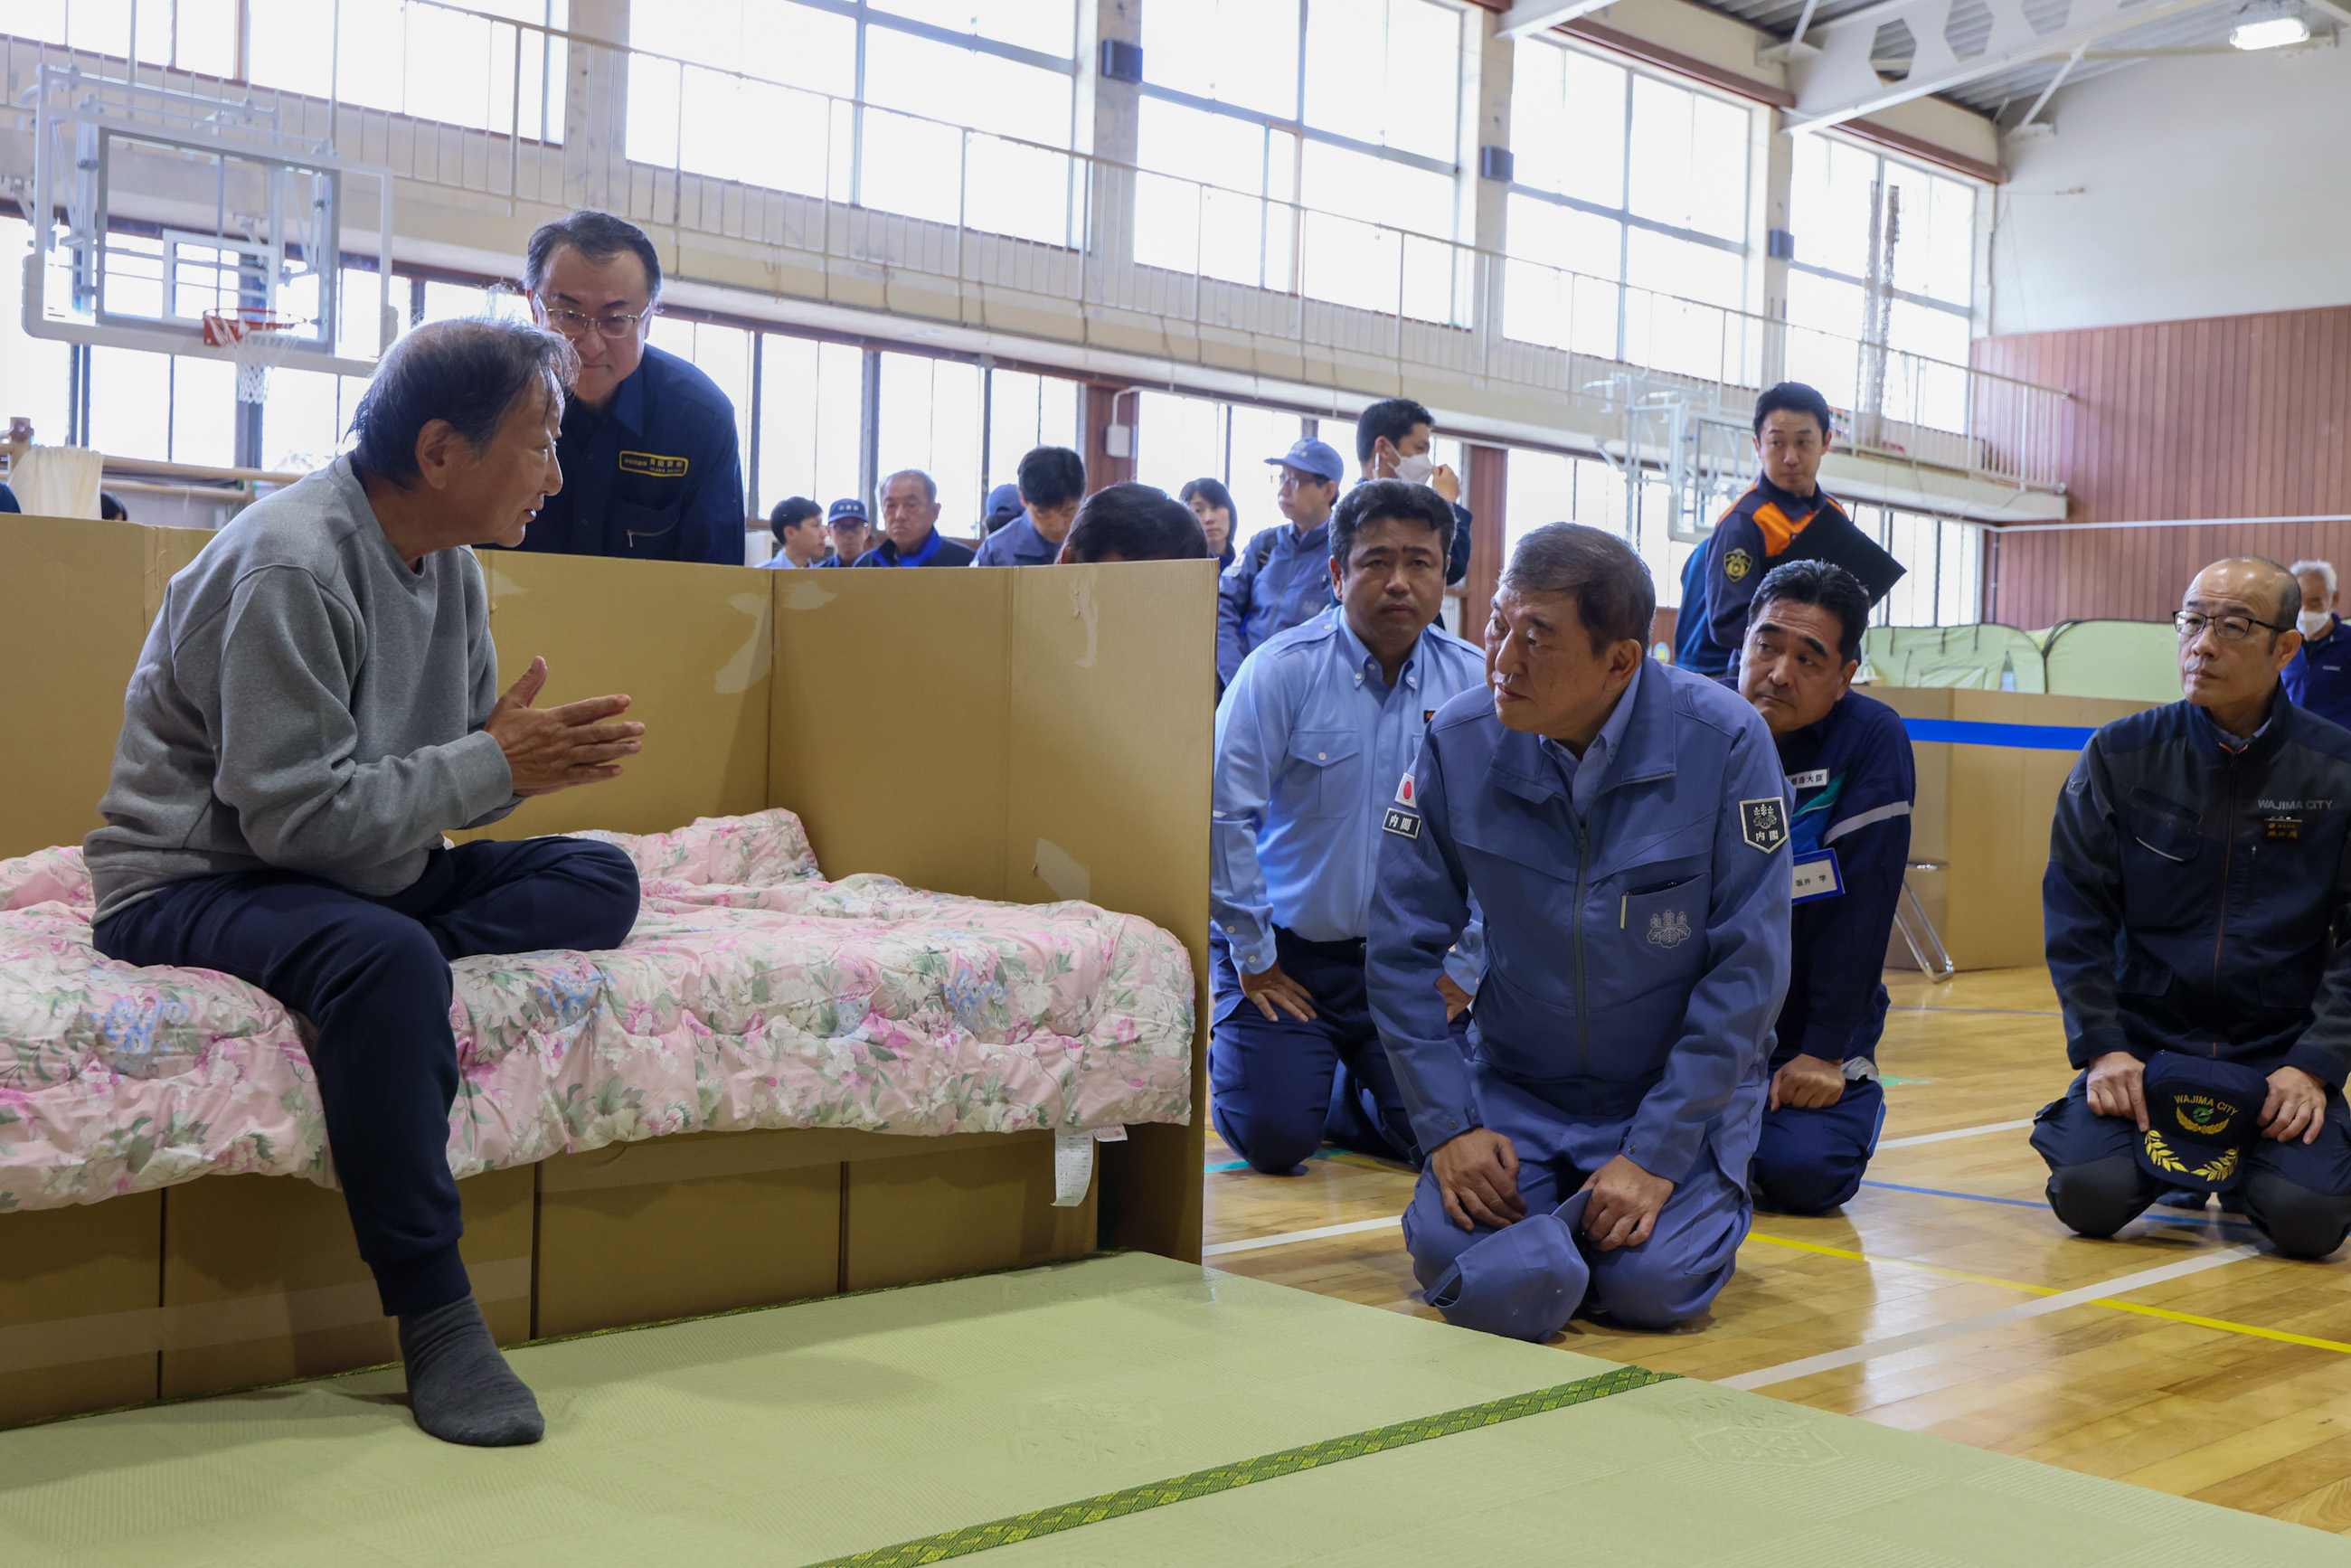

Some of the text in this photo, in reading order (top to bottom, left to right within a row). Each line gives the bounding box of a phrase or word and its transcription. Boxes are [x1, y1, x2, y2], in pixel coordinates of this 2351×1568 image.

[2258, 799, 2333, 810] WAJIMA CITY
[1388, 814, 1412, 831] 内閣
[1755, 829, 1779, 842] 内閣
[2174, 1094, 2239, 1116] WAJIMA CITY
